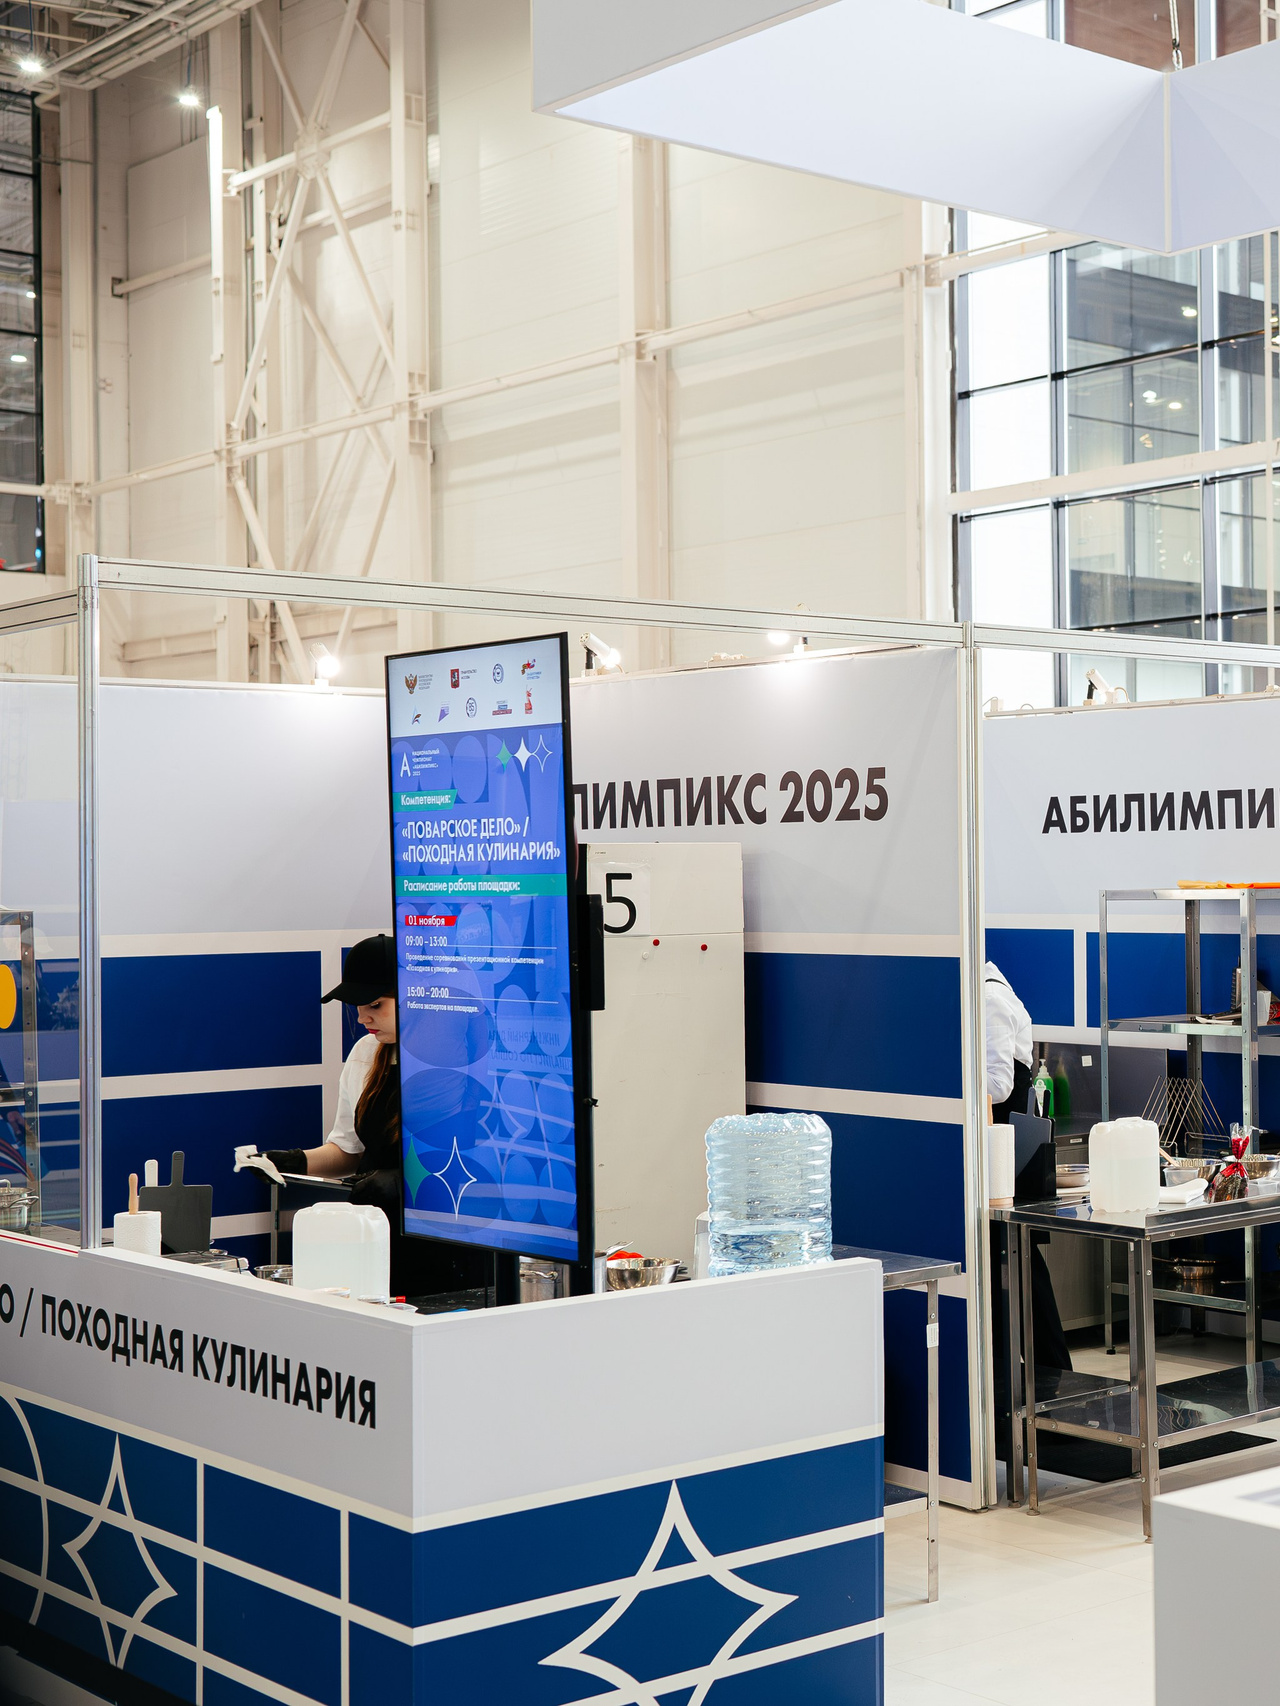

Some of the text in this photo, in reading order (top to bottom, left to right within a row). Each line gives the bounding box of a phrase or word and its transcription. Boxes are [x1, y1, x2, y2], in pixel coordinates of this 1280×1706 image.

[401, 794, 452, 807] Компетенция:
[780, 767, 889, 824] 2025
[401, 819, 478, 840] «ПОВАРСКОЕ
[480, 817, 521, 840] ДЕЛО»
[402, 841, 561, 864] «ПОХОДНАЯ КУЛИНАРИЯ»
[403, 879, 521, 893] Расписание работы площадки:
[408, 915, 446, 927] 01 ноября
[405, 936, 424, 946] 09:00
[429, 936, 448, 947] 13:00
[407, 986, 425, 998] 15:00
[431, 987, 449, 998] 20:00
[41, 1293, 184, 1373] ПОХОДНАЯ
[192, 1333, 377, 1430] КУЛИНАРИЯ
